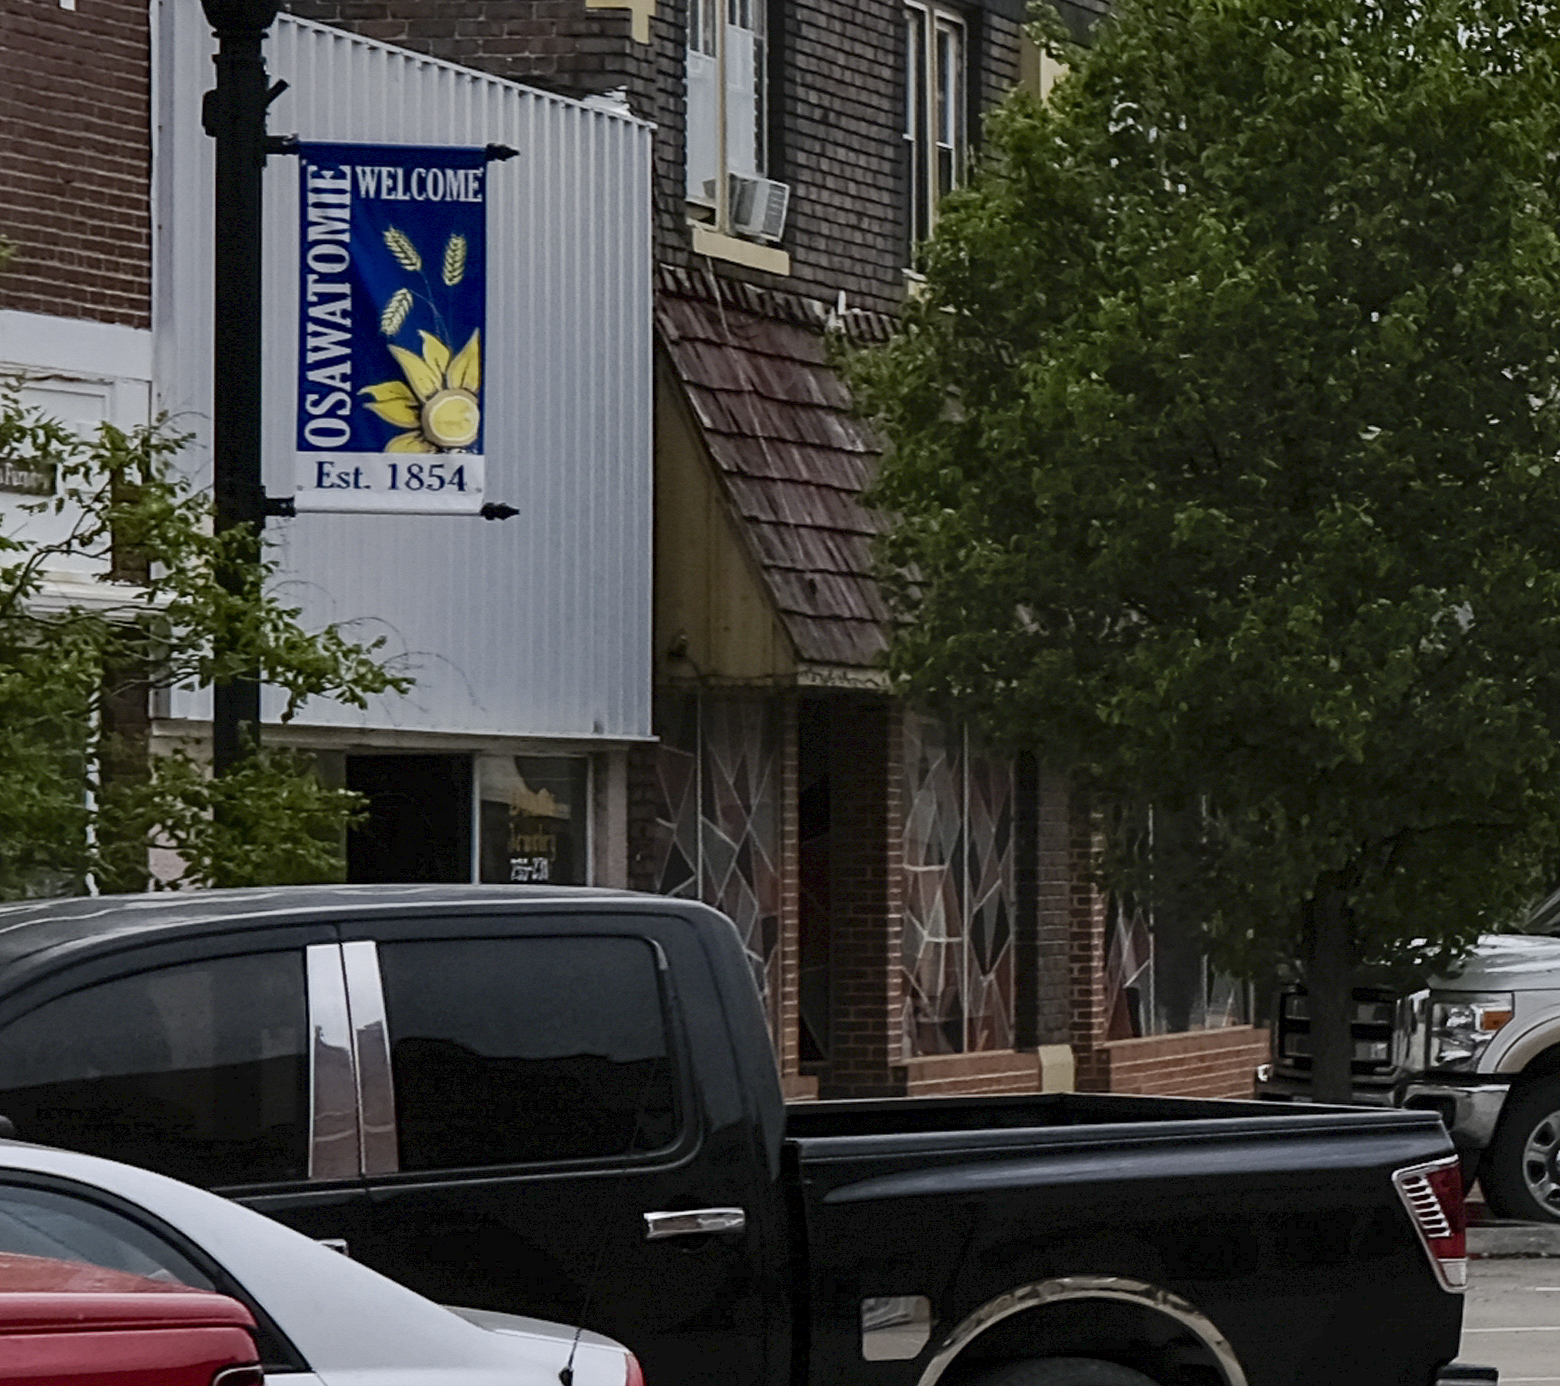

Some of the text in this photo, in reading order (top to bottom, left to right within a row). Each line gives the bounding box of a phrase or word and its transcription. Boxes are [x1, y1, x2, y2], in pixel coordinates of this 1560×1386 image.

[355, 165, 485, 202] WELCOME
[304, 165, 351, 448] OSAWATOMIE
[314, 461, 467, 492] Est. 1854
